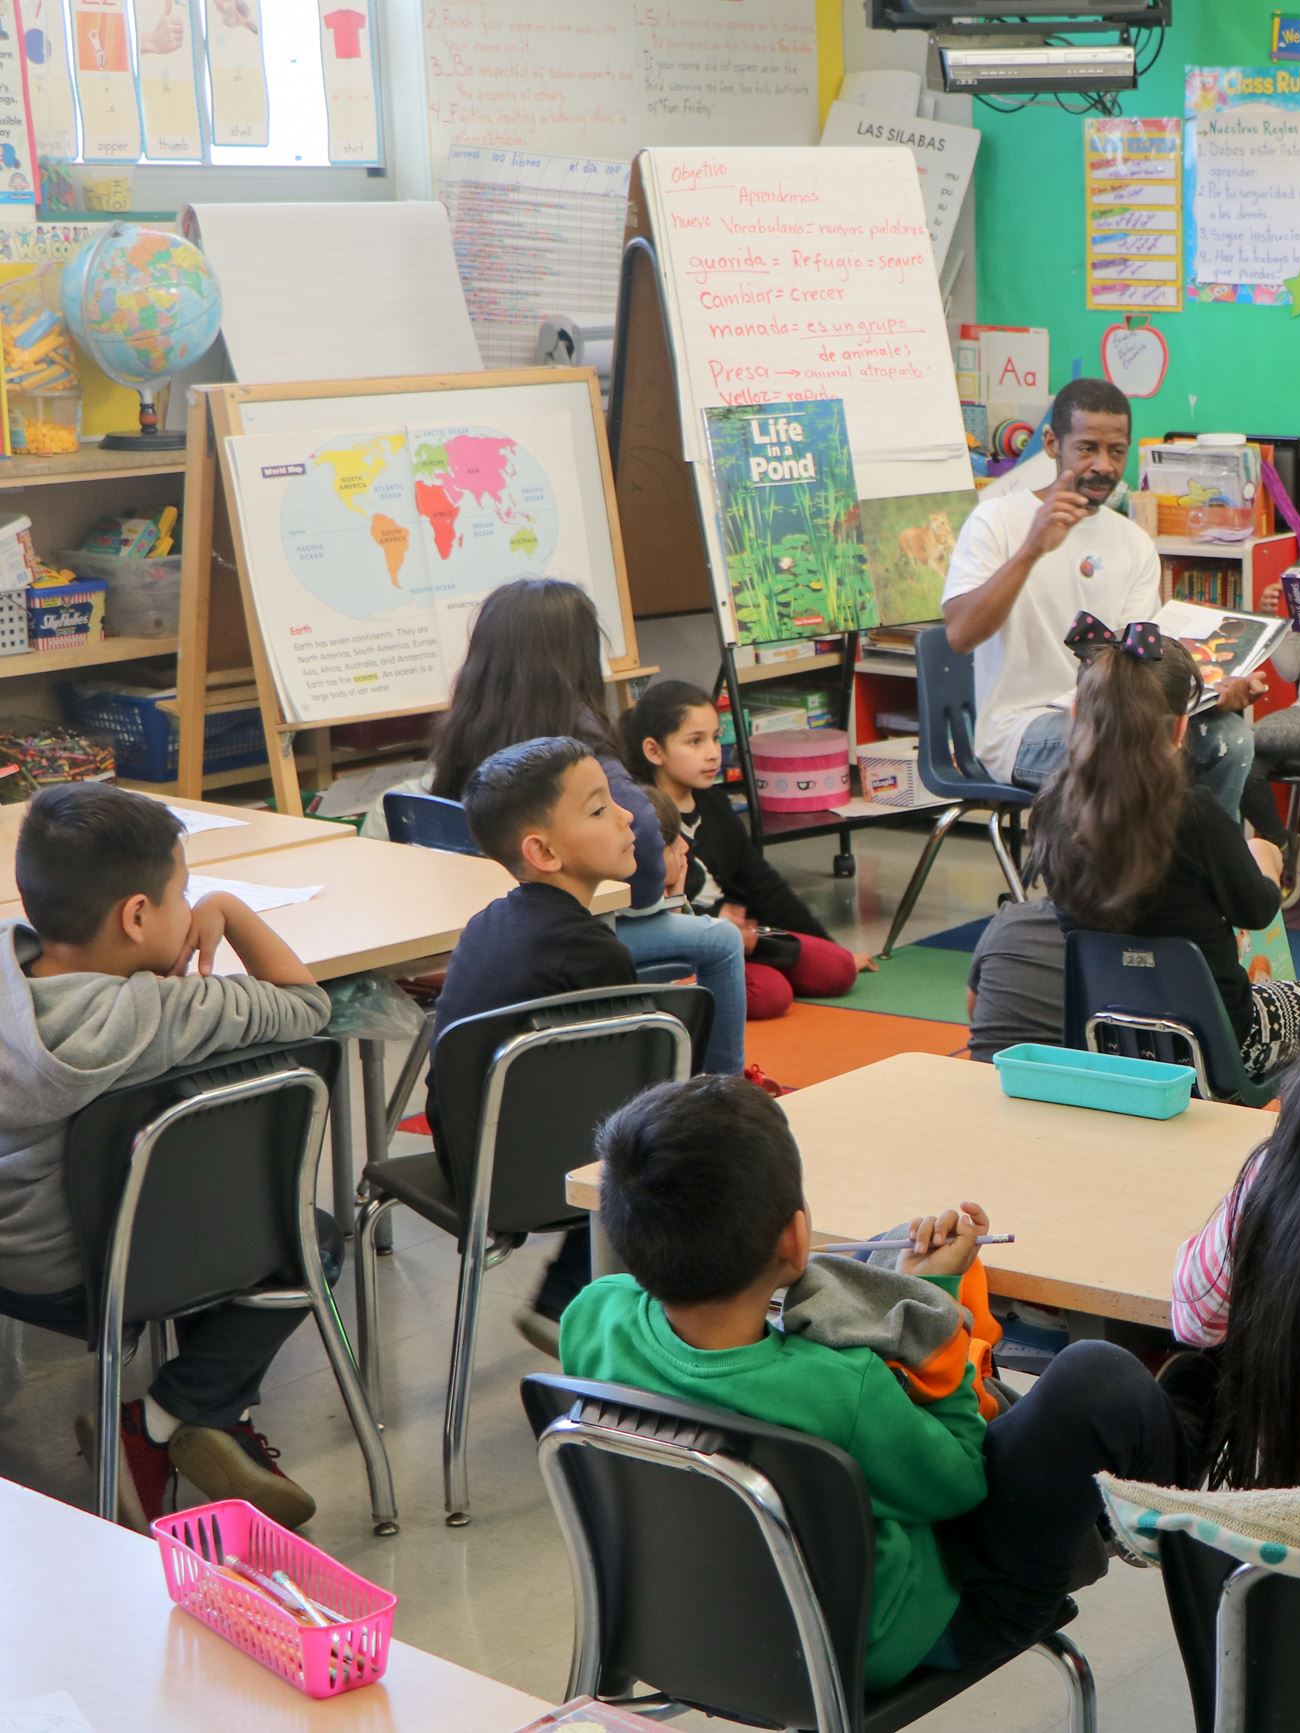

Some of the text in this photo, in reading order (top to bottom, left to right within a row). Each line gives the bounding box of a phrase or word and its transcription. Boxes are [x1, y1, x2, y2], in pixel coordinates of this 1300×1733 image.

[1224, 71, 1274, 95] Class
[230, 126, 252, 137] shell
[856, 121, 947, 152] LAS SILABAS
[1209, 118, 1299, 141] Nuestras Reglas
[98, 140, 128, 155] zipper
[158, 138, 189, 151] thumb
[818, 221, 865, 238] nuevas
[868, 216, 926, 241] palabras
[689, 246, 768, 285] guarida
[791, 249, 863, 282] Refugio
[806, 320, 828, 334] es
[833, 319, 857, 334] un
[858, 318, 908, 344] grupo
[818, 343, 912, 362] de animales
[708, 359, 771, 389] Presa
[998, 356, 1037, 387] Aa
[750, 417, 805, 445] Life
[767, 444, 793, 457] in a
[749, 452, 817, 482] Pond
[289, 625, 313, 636] Earth
